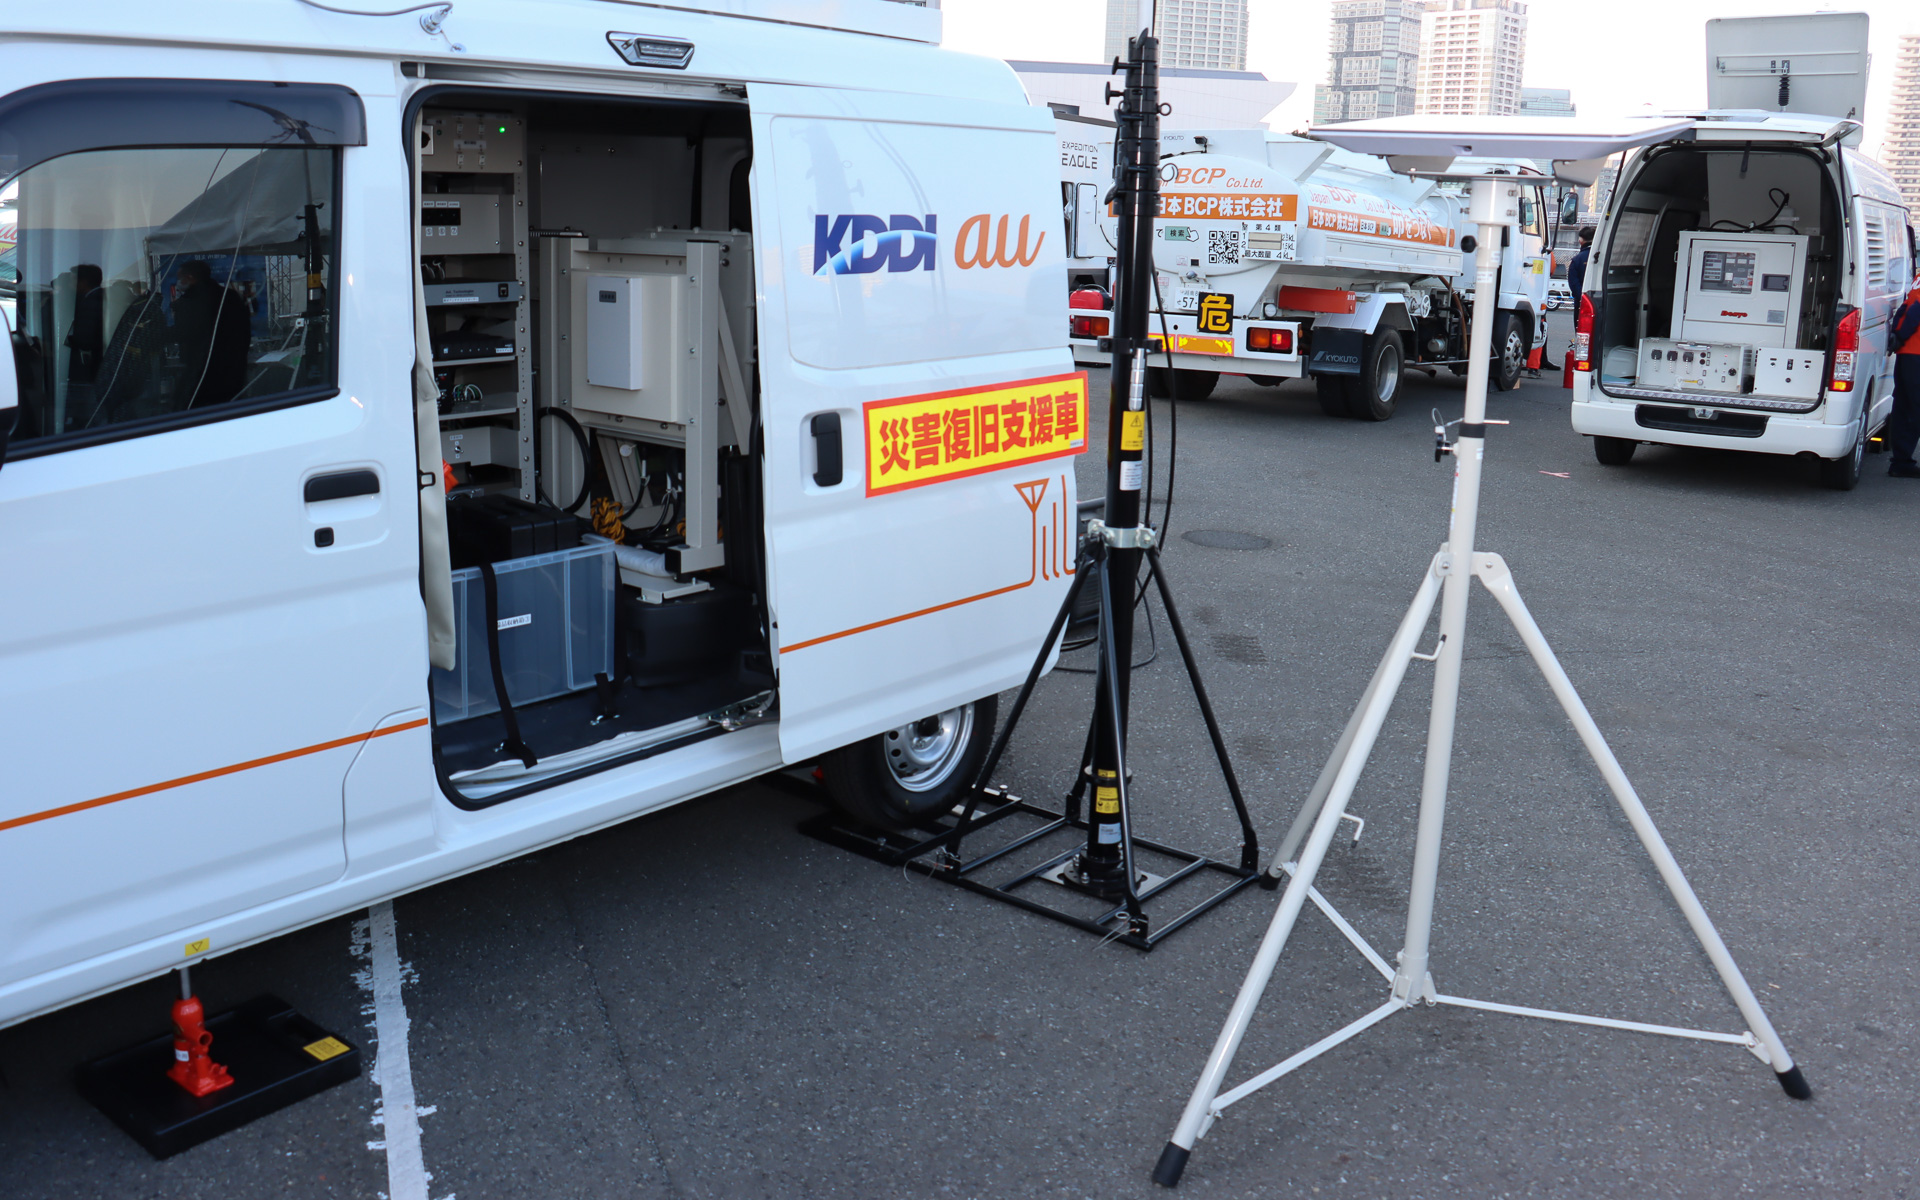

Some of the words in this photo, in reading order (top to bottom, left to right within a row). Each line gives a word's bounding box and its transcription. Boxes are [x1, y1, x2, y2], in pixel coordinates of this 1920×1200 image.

[1062, 141, 1099, 153] EXPEDITION
[1061, 153, 1098, 170] EAGLE
[1174, 167, 1226, 184] BCP
[1322, 184, 1357, 204] BCP
[1156, 228, 1164, 238] で
[1170, 229, 1185, 237] 検索
[813, 214, 937, 276] KDDI
[954, 214, 1046, 270] au
[1182, 296, 1198, 309] 57-
[1199, 294, 1232, 332] 危
[1325, 353, 1359, 364] KYOKUTO
[879, 391, 1079, 476] 災害復旧支援車
